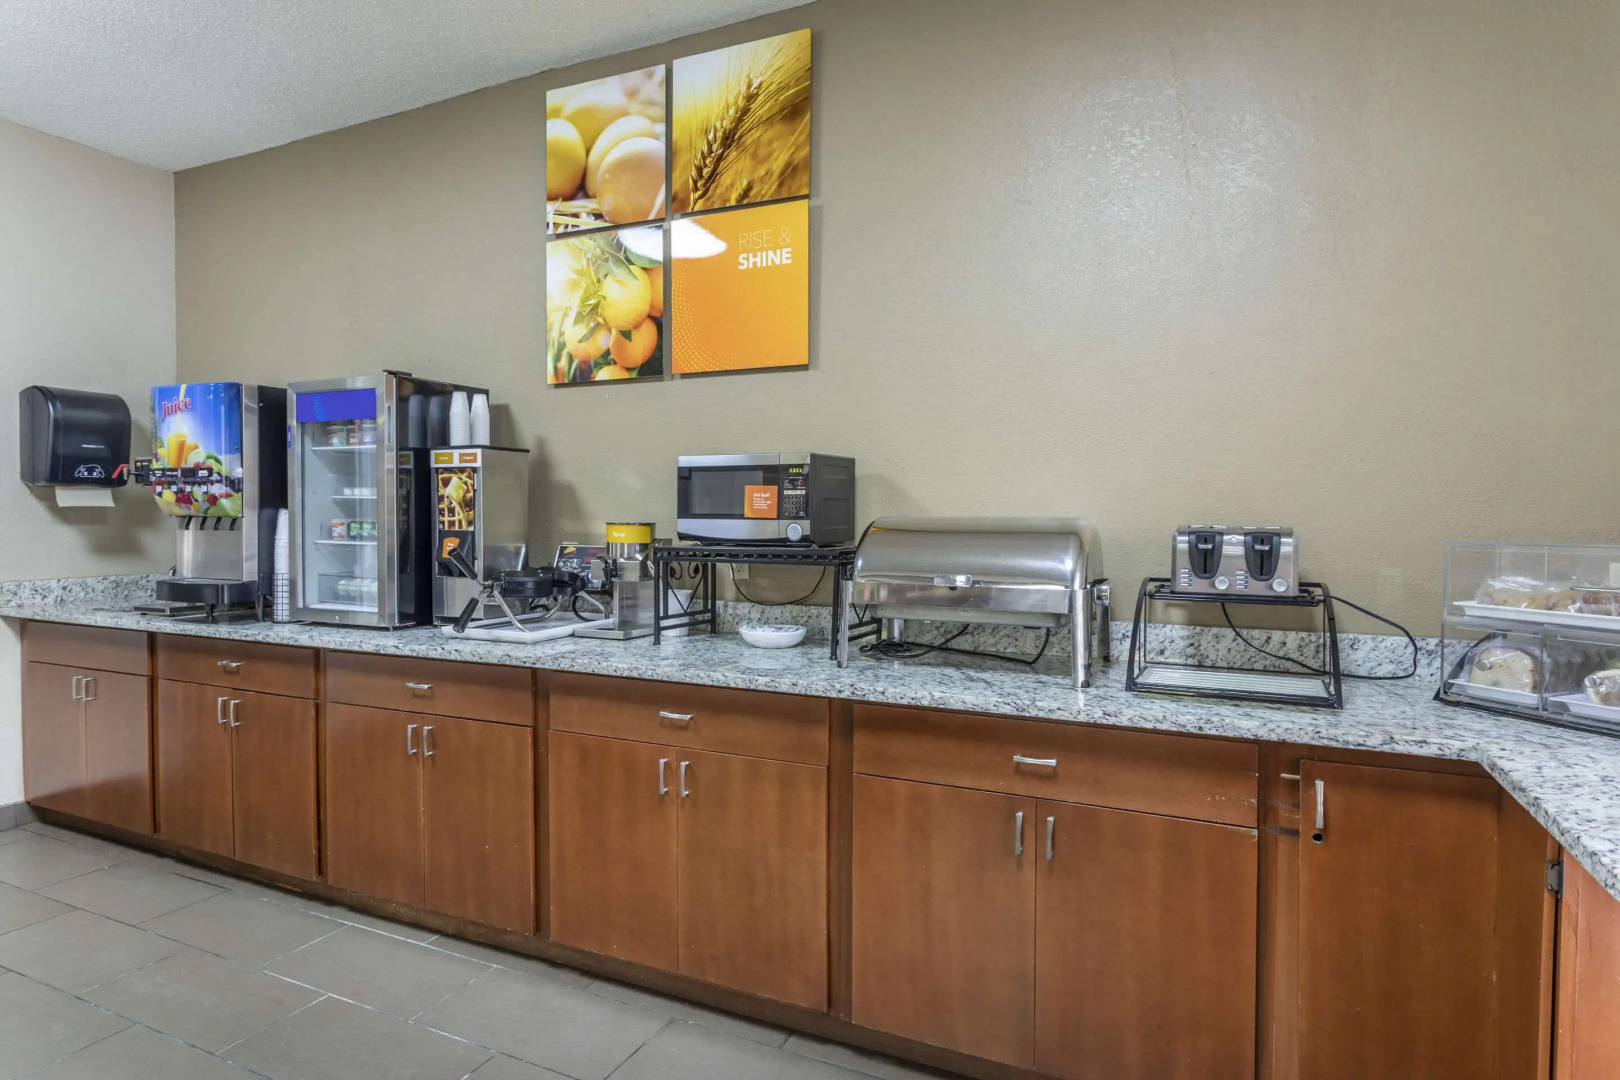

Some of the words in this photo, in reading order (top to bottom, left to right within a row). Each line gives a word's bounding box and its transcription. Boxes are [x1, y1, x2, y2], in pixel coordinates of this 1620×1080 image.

[738, 229, 773, 250] RISE
[779, 226, 791, 246] &
[738, 247, 792, 270] SHINE
[162, 397, 192, 421] Juice
